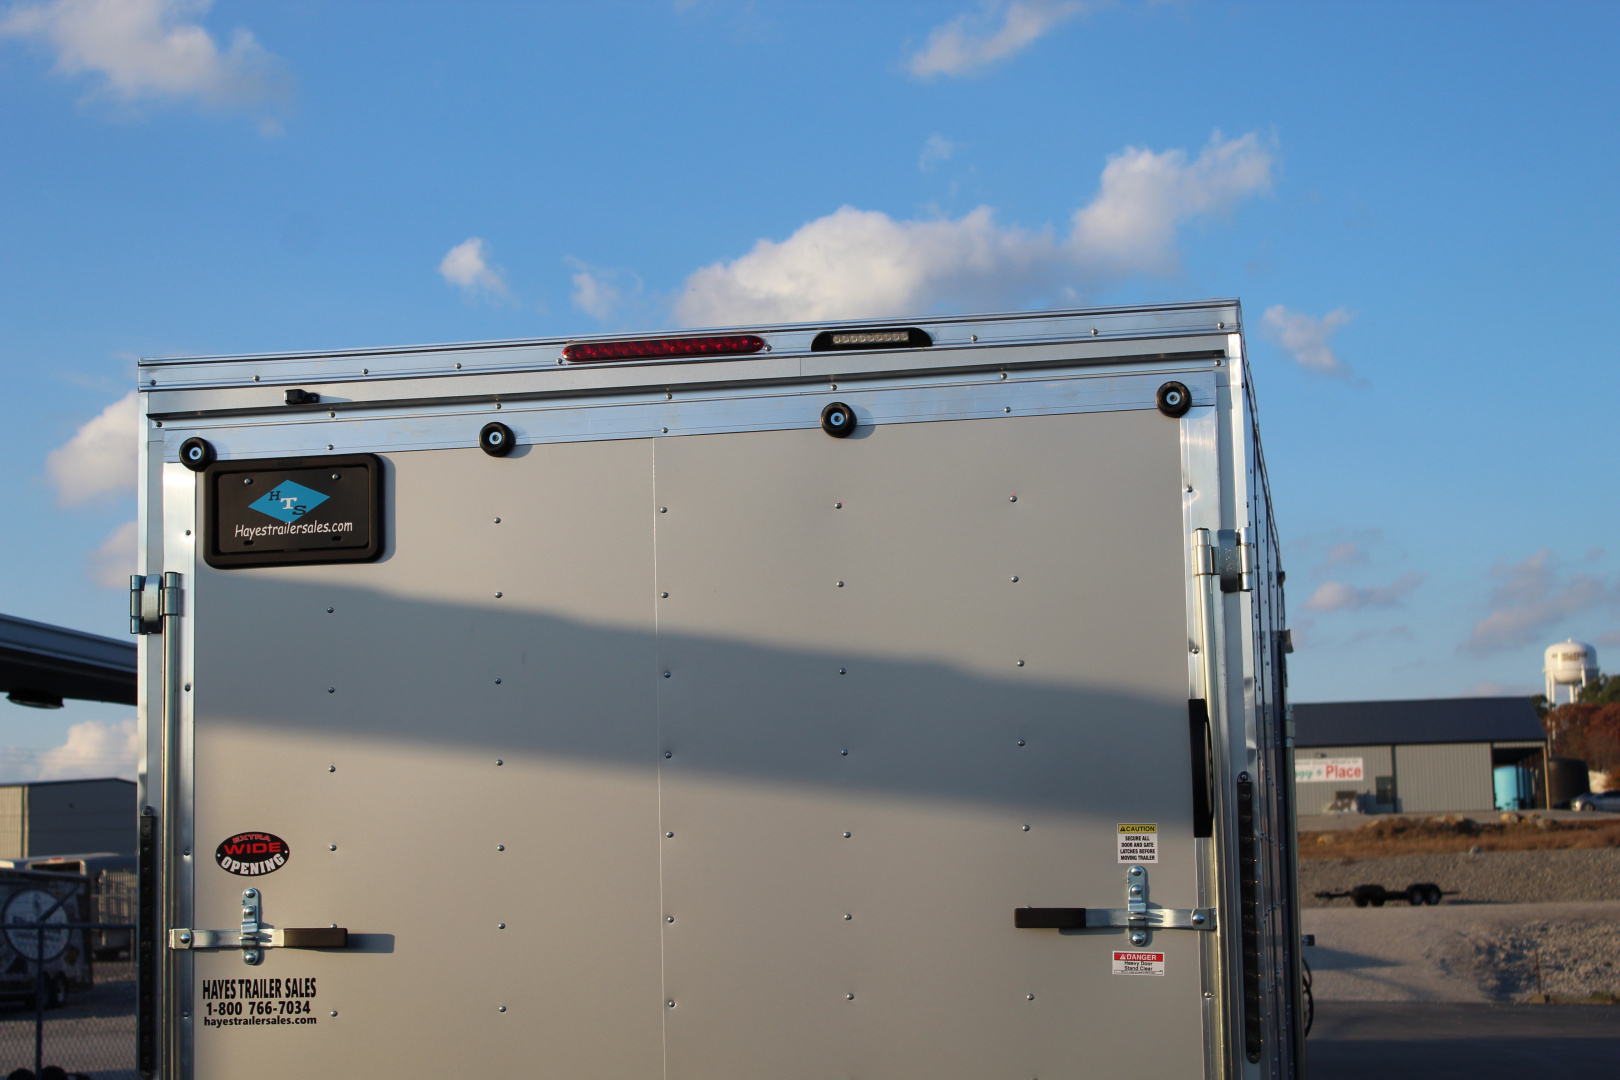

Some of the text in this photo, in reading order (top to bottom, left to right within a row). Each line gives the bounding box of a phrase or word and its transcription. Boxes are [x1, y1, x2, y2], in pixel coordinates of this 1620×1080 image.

[234, 520, 353, 540] Hayestrailersales.com
[1325, 764, 1361, 778] Place
[232, 834, 271, 843] EXTRA
[223, 842, 281, 855] WIDE
[221, 853, 285, 875] OPENING
[202, 977, 317, 999] HAYES TRAILER SALES
[206, 1000, 311, 1016] 1-800 766-7034
[203, 1015, 317, 1028] hayestrailersales.com
